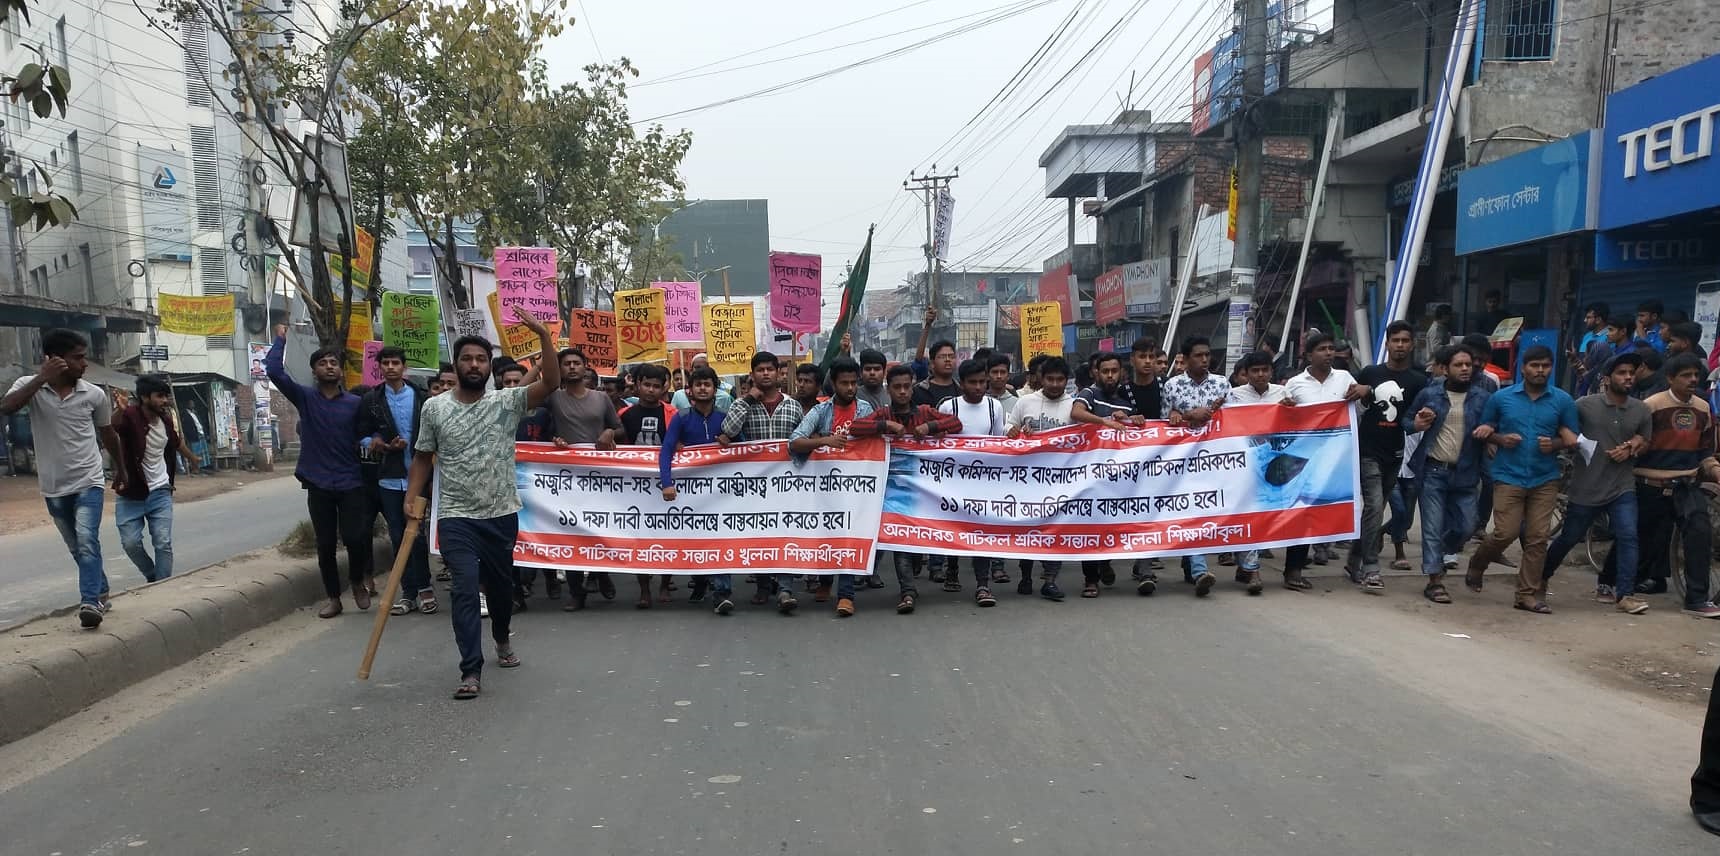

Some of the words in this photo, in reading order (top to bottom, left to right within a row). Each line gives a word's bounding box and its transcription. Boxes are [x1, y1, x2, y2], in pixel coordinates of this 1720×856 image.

[1467, 194, 1510, 218] গ্রামীণফোন
[1511, 184, 1540, 209] সেন্টার
[504, 249, 549, 264] শ্রমিকের
[621, 320, 665, 343] হটাও
[1096, 426, 1160, 442] জাতির
[919, 457, 955, 483] মজুরি
[957, 459, 1028, 484] কমিশন-সহ
[1031, 464, 1088, 485] বাংলাদেশ
[1142, 454, 1187, 477] পাটকল
[1187, 450, 1247, 473] শ্রমিকদের
[534, 469, 573, 496] মজুরি
[576, 471, 652, 494] কমিশন-সহ
[654, 476, 713, 495] বলাদেশ
[771, 471, 816, 493] পাটকল
[819, 468, 877, 494] শ্রমিকদের
[940, 496, 959, 513] ১১
[963, 498, 987, 516] দফা
[991, 494, 1017, 518] দাবী
[1020, 495, 1093, 518] অনতিবিলম্বে
[1097, 496, 1150, 518] বাস্তবায়ন
[1154, 493, 1190, 513] করতে
[558, 510, 578, 527] ১১
[583, 511, 609, 529] দফা
[613, 506, 641, 530] দাবী
[644, 506, 719, 532] অনতিবিলম্বে
[723, 511, 779, 532] বাস্তবায়ন
[782, 511, 820, 530] করতে
[883, 523, 954, 543] অনশনরত
[958, 531, 1010, 547] পাটকল
[1014, 530, 1057, 547] শ্রমিক
[1060, 534, 1100, 549] সন্তান
[1104, 534, 1115, 547] ও
[1120, 531, 1162, 551] খুলনা
[513, 540, 574, 559] নশনরত
[578, 544, 634, 562] পাটকল
[636, 544, 678, 563] শ্রমিক
[682, 549, 720, 564] সন্তান
[723, 549, 734, 562] ও
[739, 548, 780, 566] খুলনা
